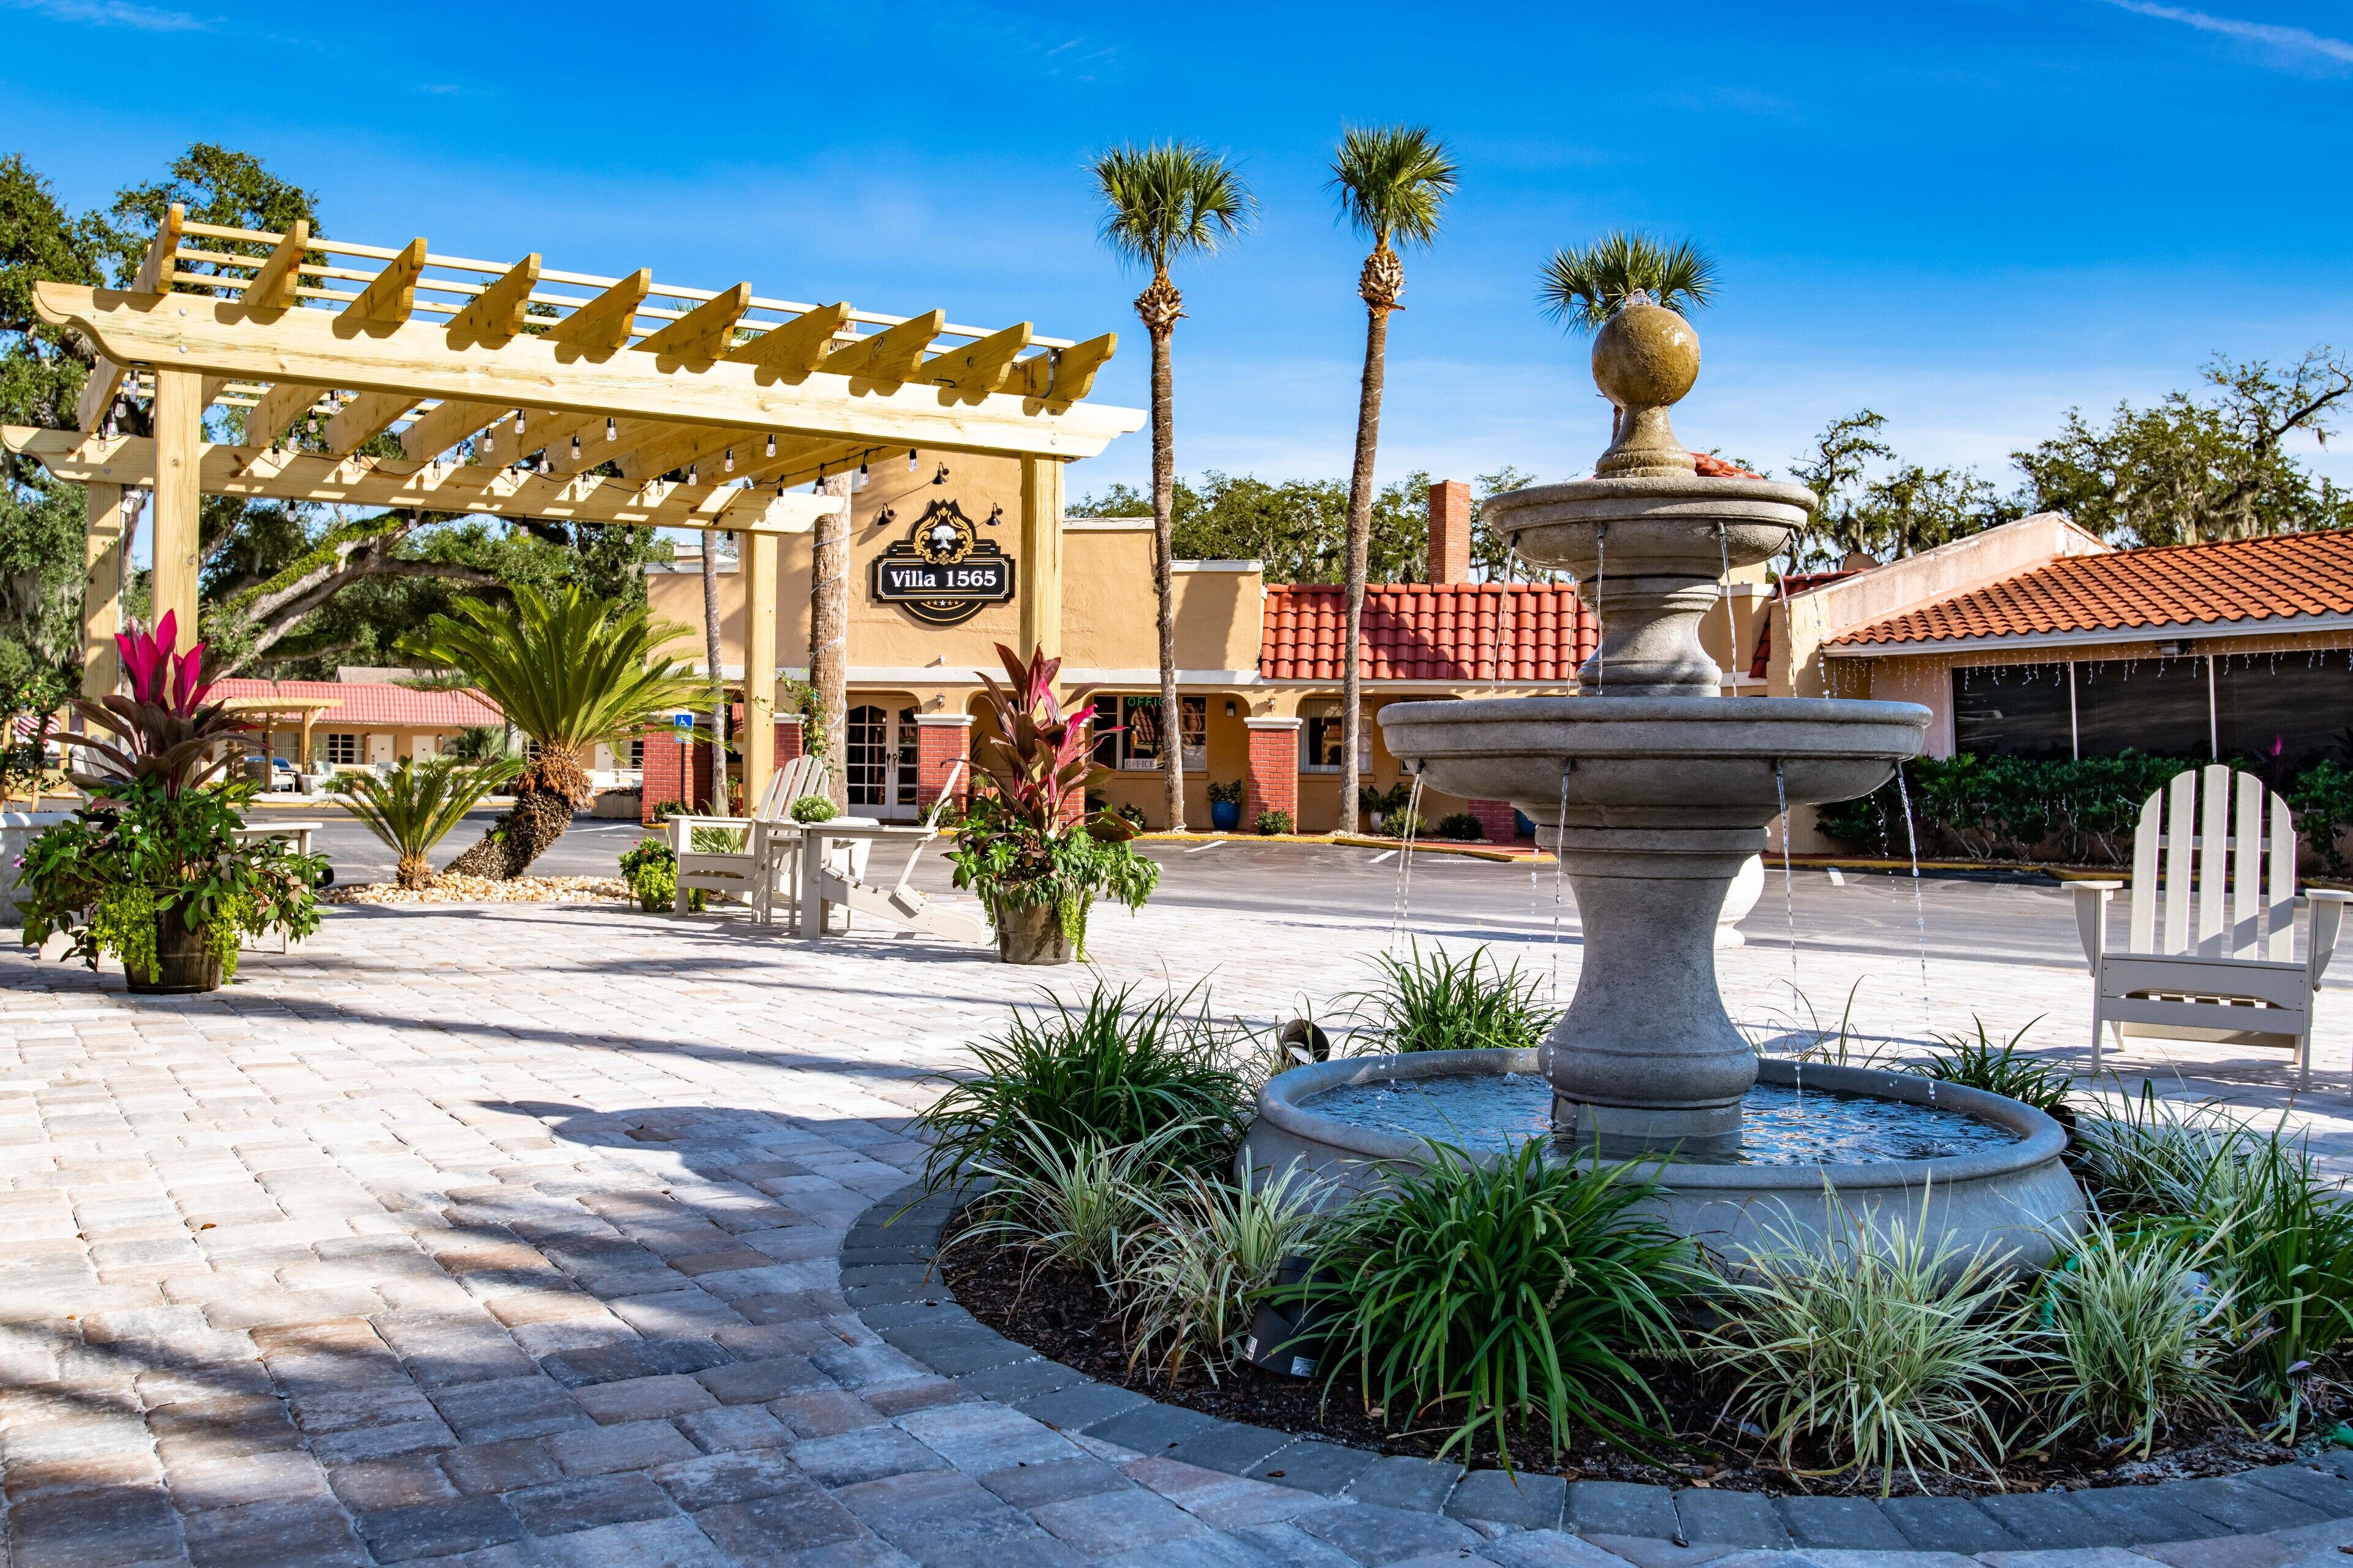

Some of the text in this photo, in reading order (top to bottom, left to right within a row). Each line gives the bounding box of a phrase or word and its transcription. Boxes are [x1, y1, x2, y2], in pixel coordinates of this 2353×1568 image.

[890, 570, 997, 587] Villa 1565
[1126, 760, 1155, 768] OFFICE
